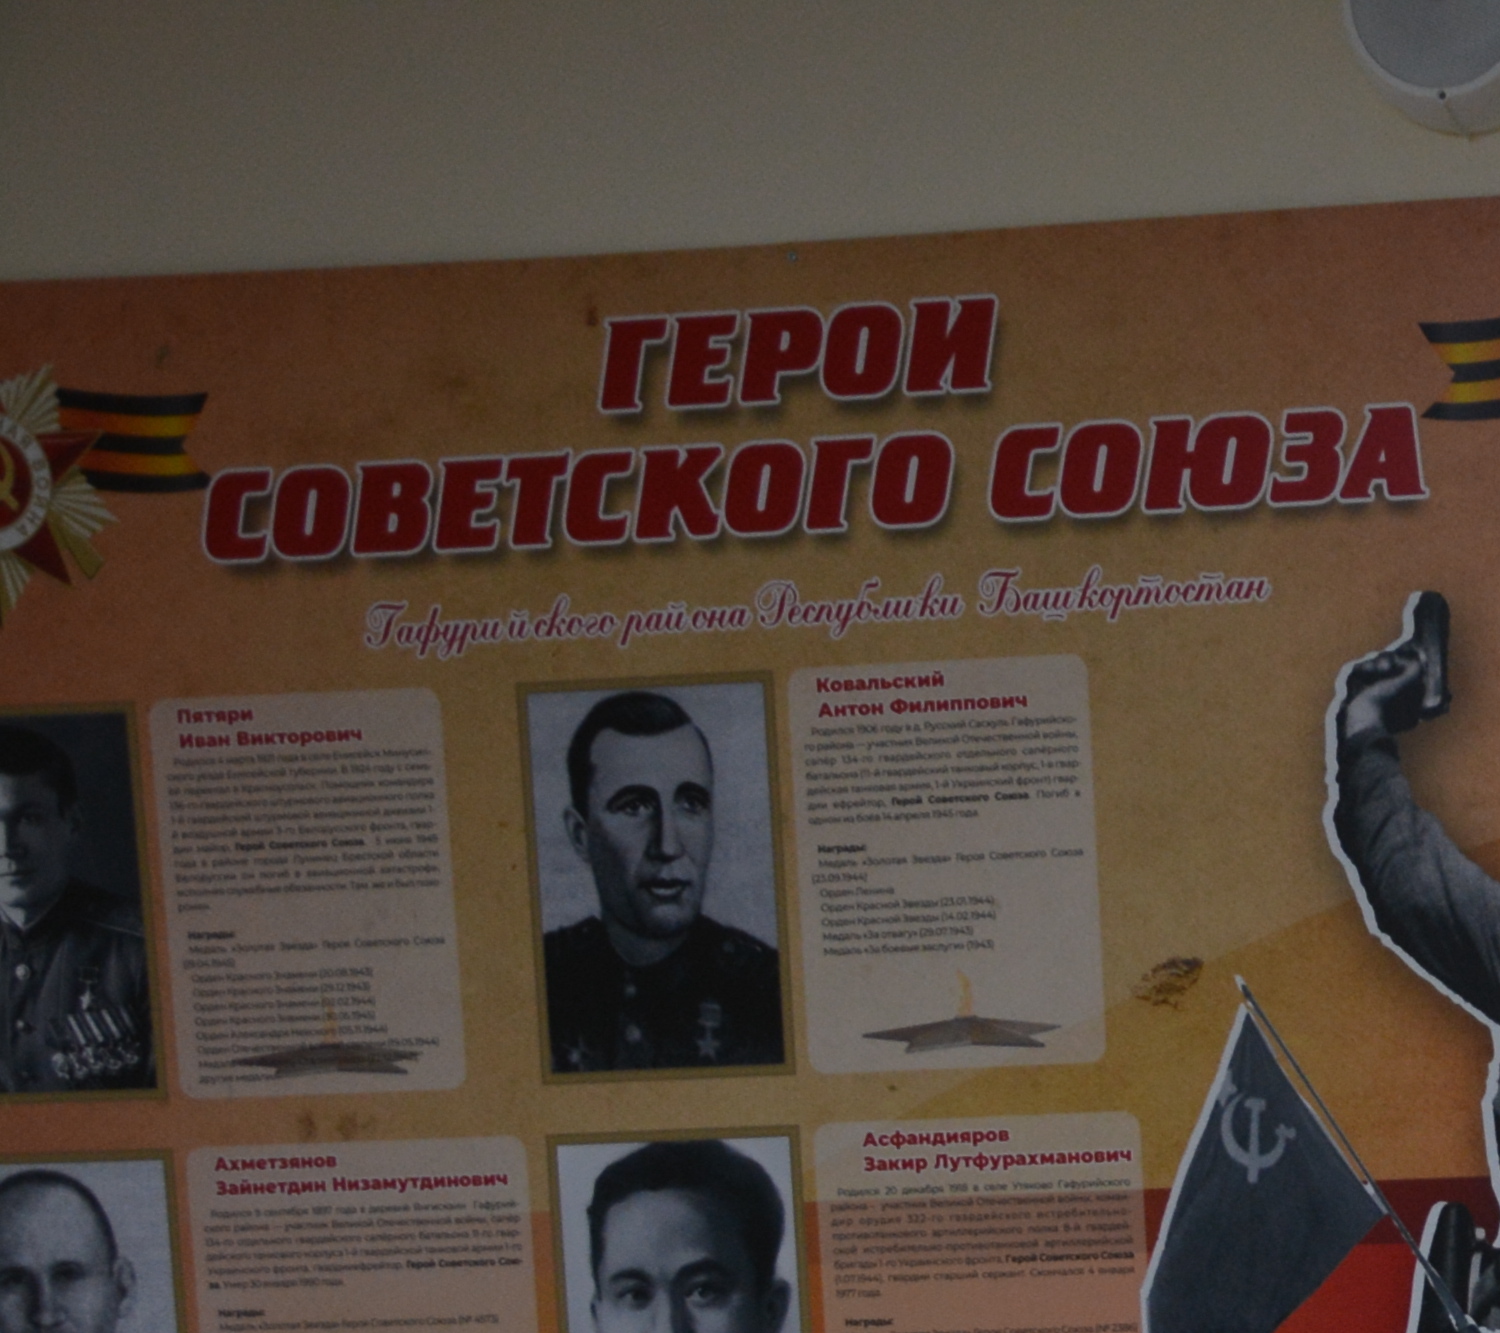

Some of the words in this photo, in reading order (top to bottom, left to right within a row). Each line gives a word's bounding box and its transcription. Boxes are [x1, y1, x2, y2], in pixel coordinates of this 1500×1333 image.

[601, 293, 999, 413] ГЕРОИ
[205, 432, 955, 565] СОВЕТСКОГО
[990, 402, 1429, 522] СОЮЗА
[365, 583, 614, 659] Гафурийского
[619, 594, 752, 647] района
[756, 571, 963, 639] Республики
[978, 566, 1271, 625] Башкортостан
[816, 671, 944, 693] Ковальский
[177, 707, 254, 726] Пятяри
[818, 701, 884, 718] Антон
[890, 695, 1028, 715] Филиппович
[180, 732, 230, 749] Иван
[237, 728, 363, 747] Викторович
[863, 1128, 1010, 1149] Асфандияров
[214, 1155, 337, 1173] Ахметзянов
[863, 1155, 928, 1174] Закир
[934, 1149, 1133, 1172] Лутфурахманович
[216, 1177, 326, 1198] Зайнетдин
[333, 1171, 509, 1193] Низамутдинович
